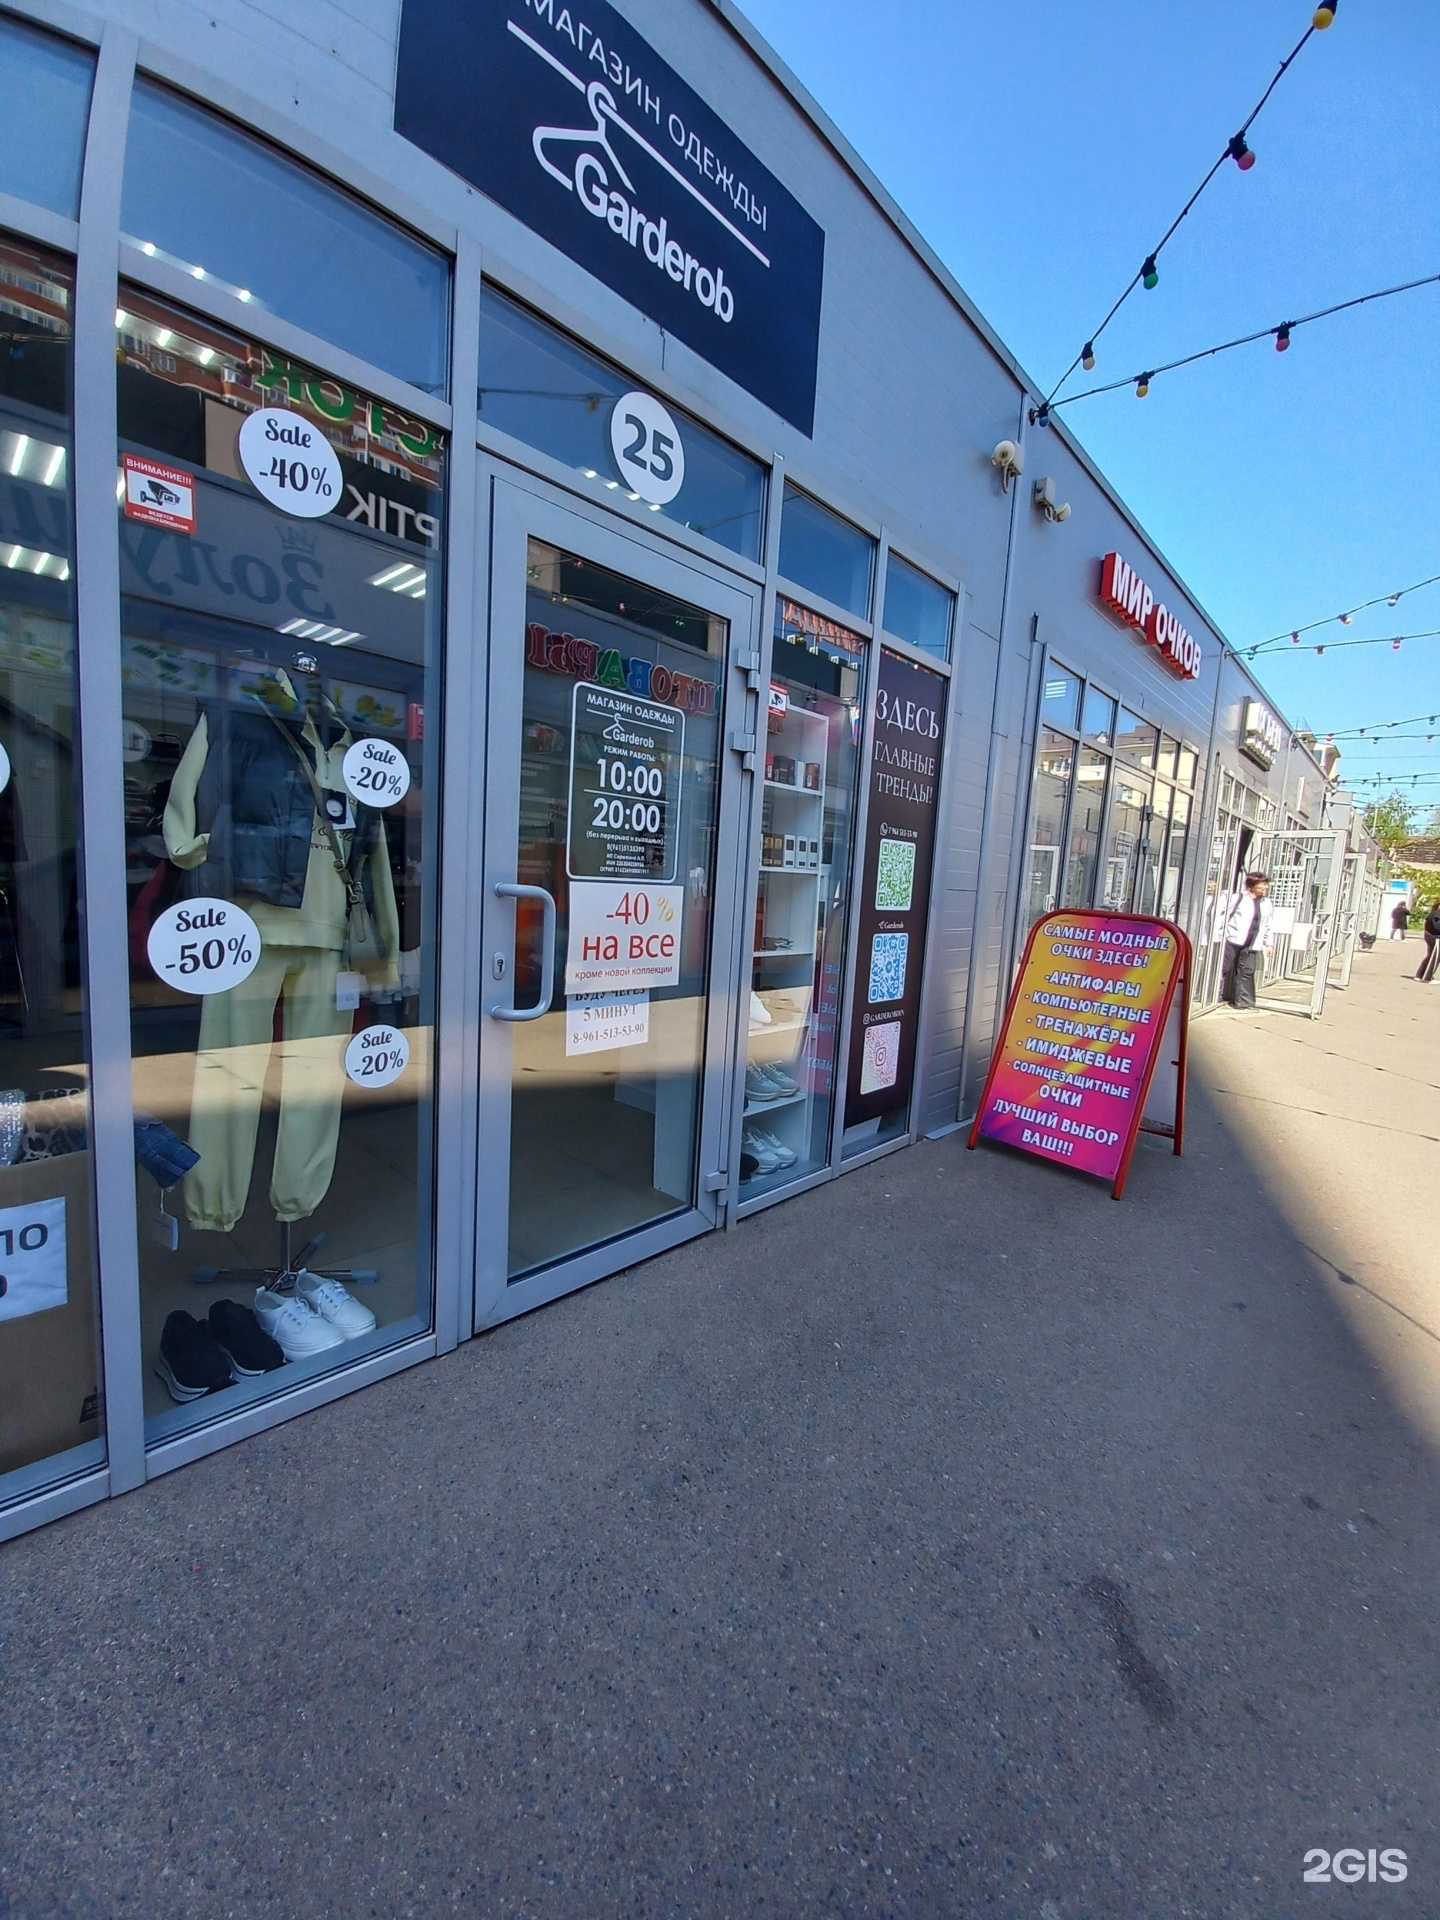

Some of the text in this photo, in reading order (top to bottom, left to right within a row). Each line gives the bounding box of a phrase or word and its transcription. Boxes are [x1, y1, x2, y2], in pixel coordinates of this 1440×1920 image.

[525, 0, 767, 231] МАГАЗИН ОДЕЖДЫ
[575, 153, 734, 323] Garderob
[265, 418, 311, 448] Sale
[623, 413, 674, 481] 25
[127, 458, 192, 485] ВНИМАНИЕ!!!
[259, 456, 332, 496] -40%
[1112, 552, 1201, 679] МИР ОЧКОВ
[586, 693, 675, 725] МАГАЗИН ОДЕЖДЫ
[876, 689, 940, 739] ЗДЕСЬ
[363, 743, 397, 765] Sale
[604, 745, 628, 757] РЕЖИМ
[612, 729, 655, 748] Garderob
[874, 740, 936, 777] ГЛАВНЫЕ
[350, 766, 402, 796] -20%
[597, 758, 662, 796] 10:00
[876, 772, 934, 804] ТРЕНДЫ!
[592, 797, 660, 833] 20:00
[176, 908, 226, 932] Sale
[606, 892, 649, 925] -40
[583, 934, 675, 961] на все
[1043, 924, 1170, 951] САМЫЕ МОДНЫЕ
[165, 934, 252, 974] -50%
[1051, 943, 1150, 969] ОЧКИ ЗДЕСЬ!
[576, 966, 673, 981] кроме новой коллекции
[583, 1004, 637, 1022] 5 МИНУТ
[1032, 990, 1152, 1025] КОМПЬЮТЕРНЫЕ
[361, 1031, 393, 1049] Sale
[573, 1023, 645, 1044] 8-961-513-53-90
[1036, 1014, 1136, 1048] ТРЕНАЖЁРЫ
[353, 1048, 404, 1076] -20%
[1025, 1037, 1132, 1074] ИМИДЖЕВЫЕ
[1012, 1059, 1131, 1099] СОЛНЦЕЗАЩИТНЫЕ
[1039, 1084, 1083, 1108] ОЧКИ
[993, 1099, 1119, 1146] ЛУЧШИЙ ВЫБОР
[1021, 1128, 1074, 1156] ВАШ!!!
